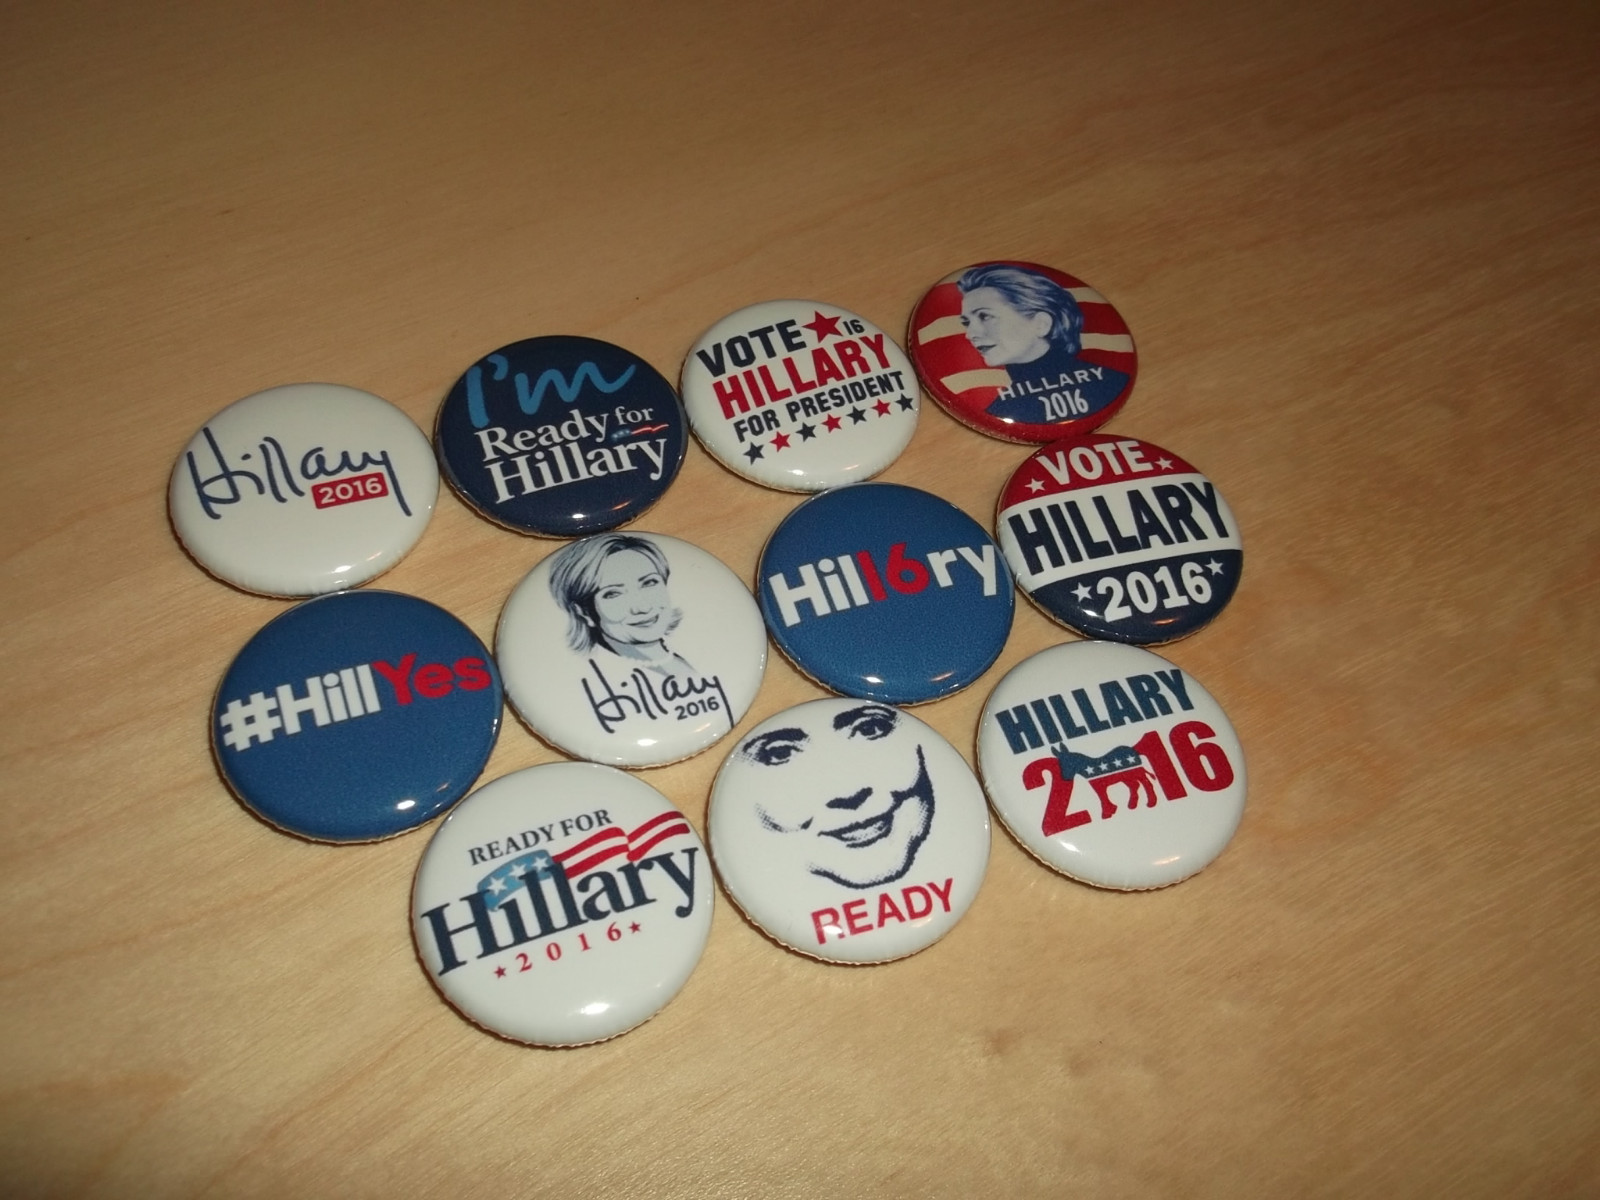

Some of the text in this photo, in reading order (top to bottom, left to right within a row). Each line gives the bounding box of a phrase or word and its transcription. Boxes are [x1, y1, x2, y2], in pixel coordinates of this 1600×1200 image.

[696, 319, 865, 378] VOTE 16
[712, 333, 891, 420] HILLARY
[466, 355, 636, 428] I'm
[733, 371, 905, 443] FOR PRESIDENT
[997, 367, 1104, 402] HILLARY
[1038, 389, 1089, 423] 2016
[474, 405, 655, 465] Ready for
[1035, 440, 1154, 485] VOTE
[186, 427, 412, 519] Hillary
[318, 477, 383, 505] 2016
[486, 437, 667, 504] Hillary
[1007, 482, 1230, 576] HILLARY
[1097, 560, 1213, 623] 2016
[219, 653, 492, 752] #HillYes
[675, 698, 720, 720] 2016
[994, 669, 1195, 755] HILLARY
[1021, 720, 1235, 837] 216
[468, 809, 613, 866] READY FOR
[420, 846, 700, 977] Hillary
[810, 878, 955, 945] READY
